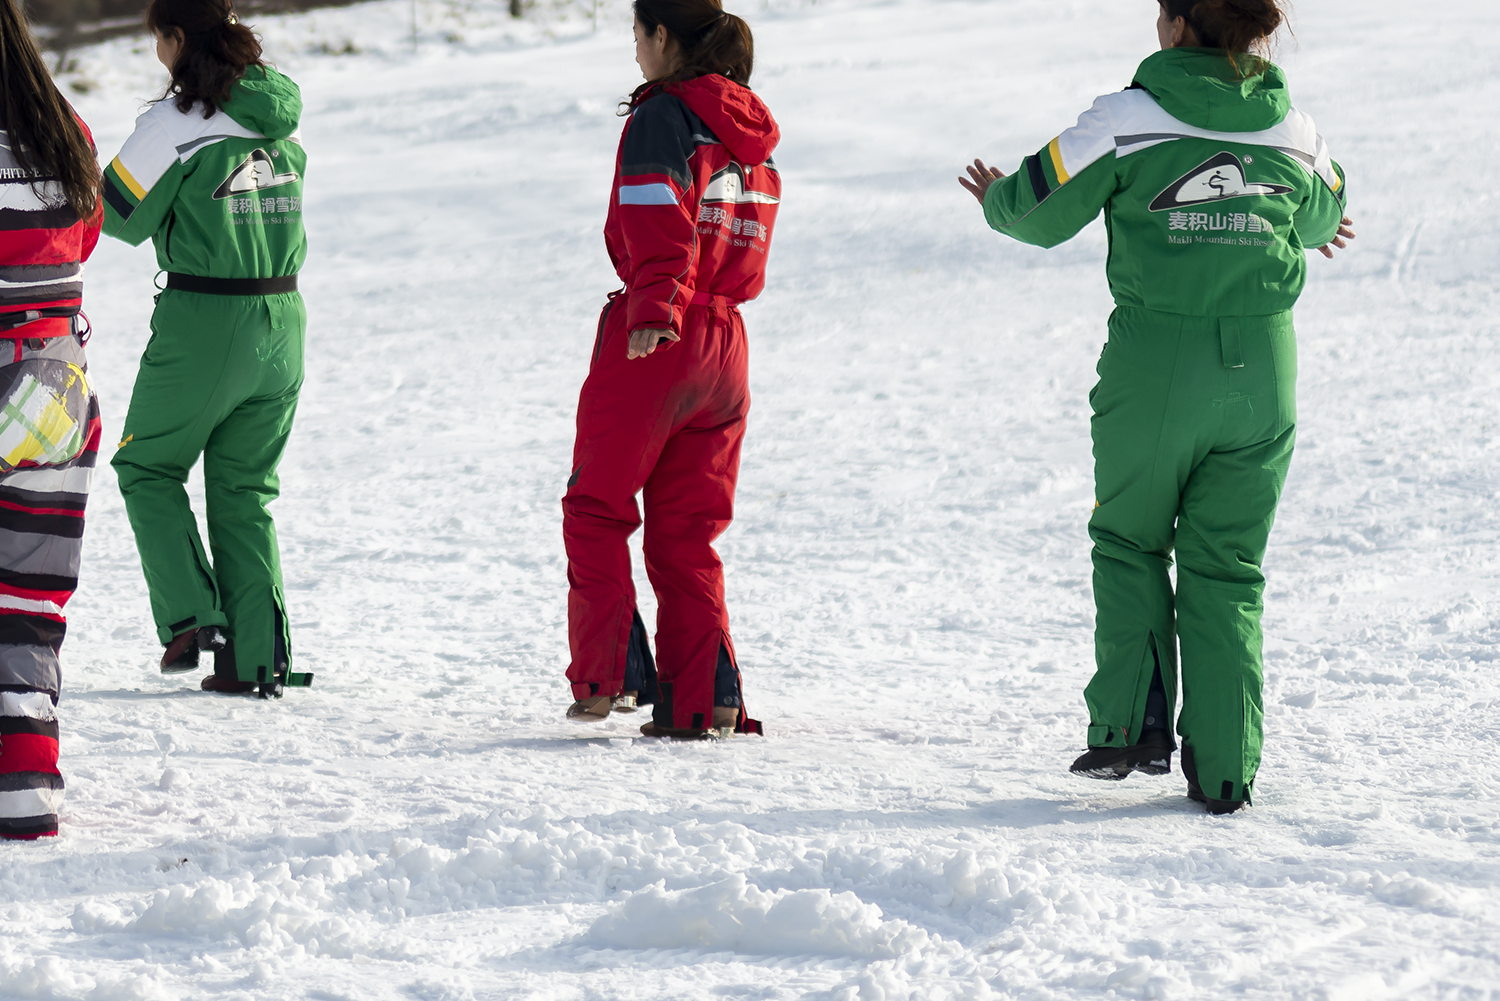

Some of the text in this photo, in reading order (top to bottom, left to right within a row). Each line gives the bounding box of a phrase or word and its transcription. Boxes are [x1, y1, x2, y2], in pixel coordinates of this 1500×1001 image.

[228, 196, 301, 214] 麦积山滑雪场
[734, 239, 746, 247] Ski
[1195, 235, 1236, 245] Mountain
[1239, 237, 1251, 246] Ski
